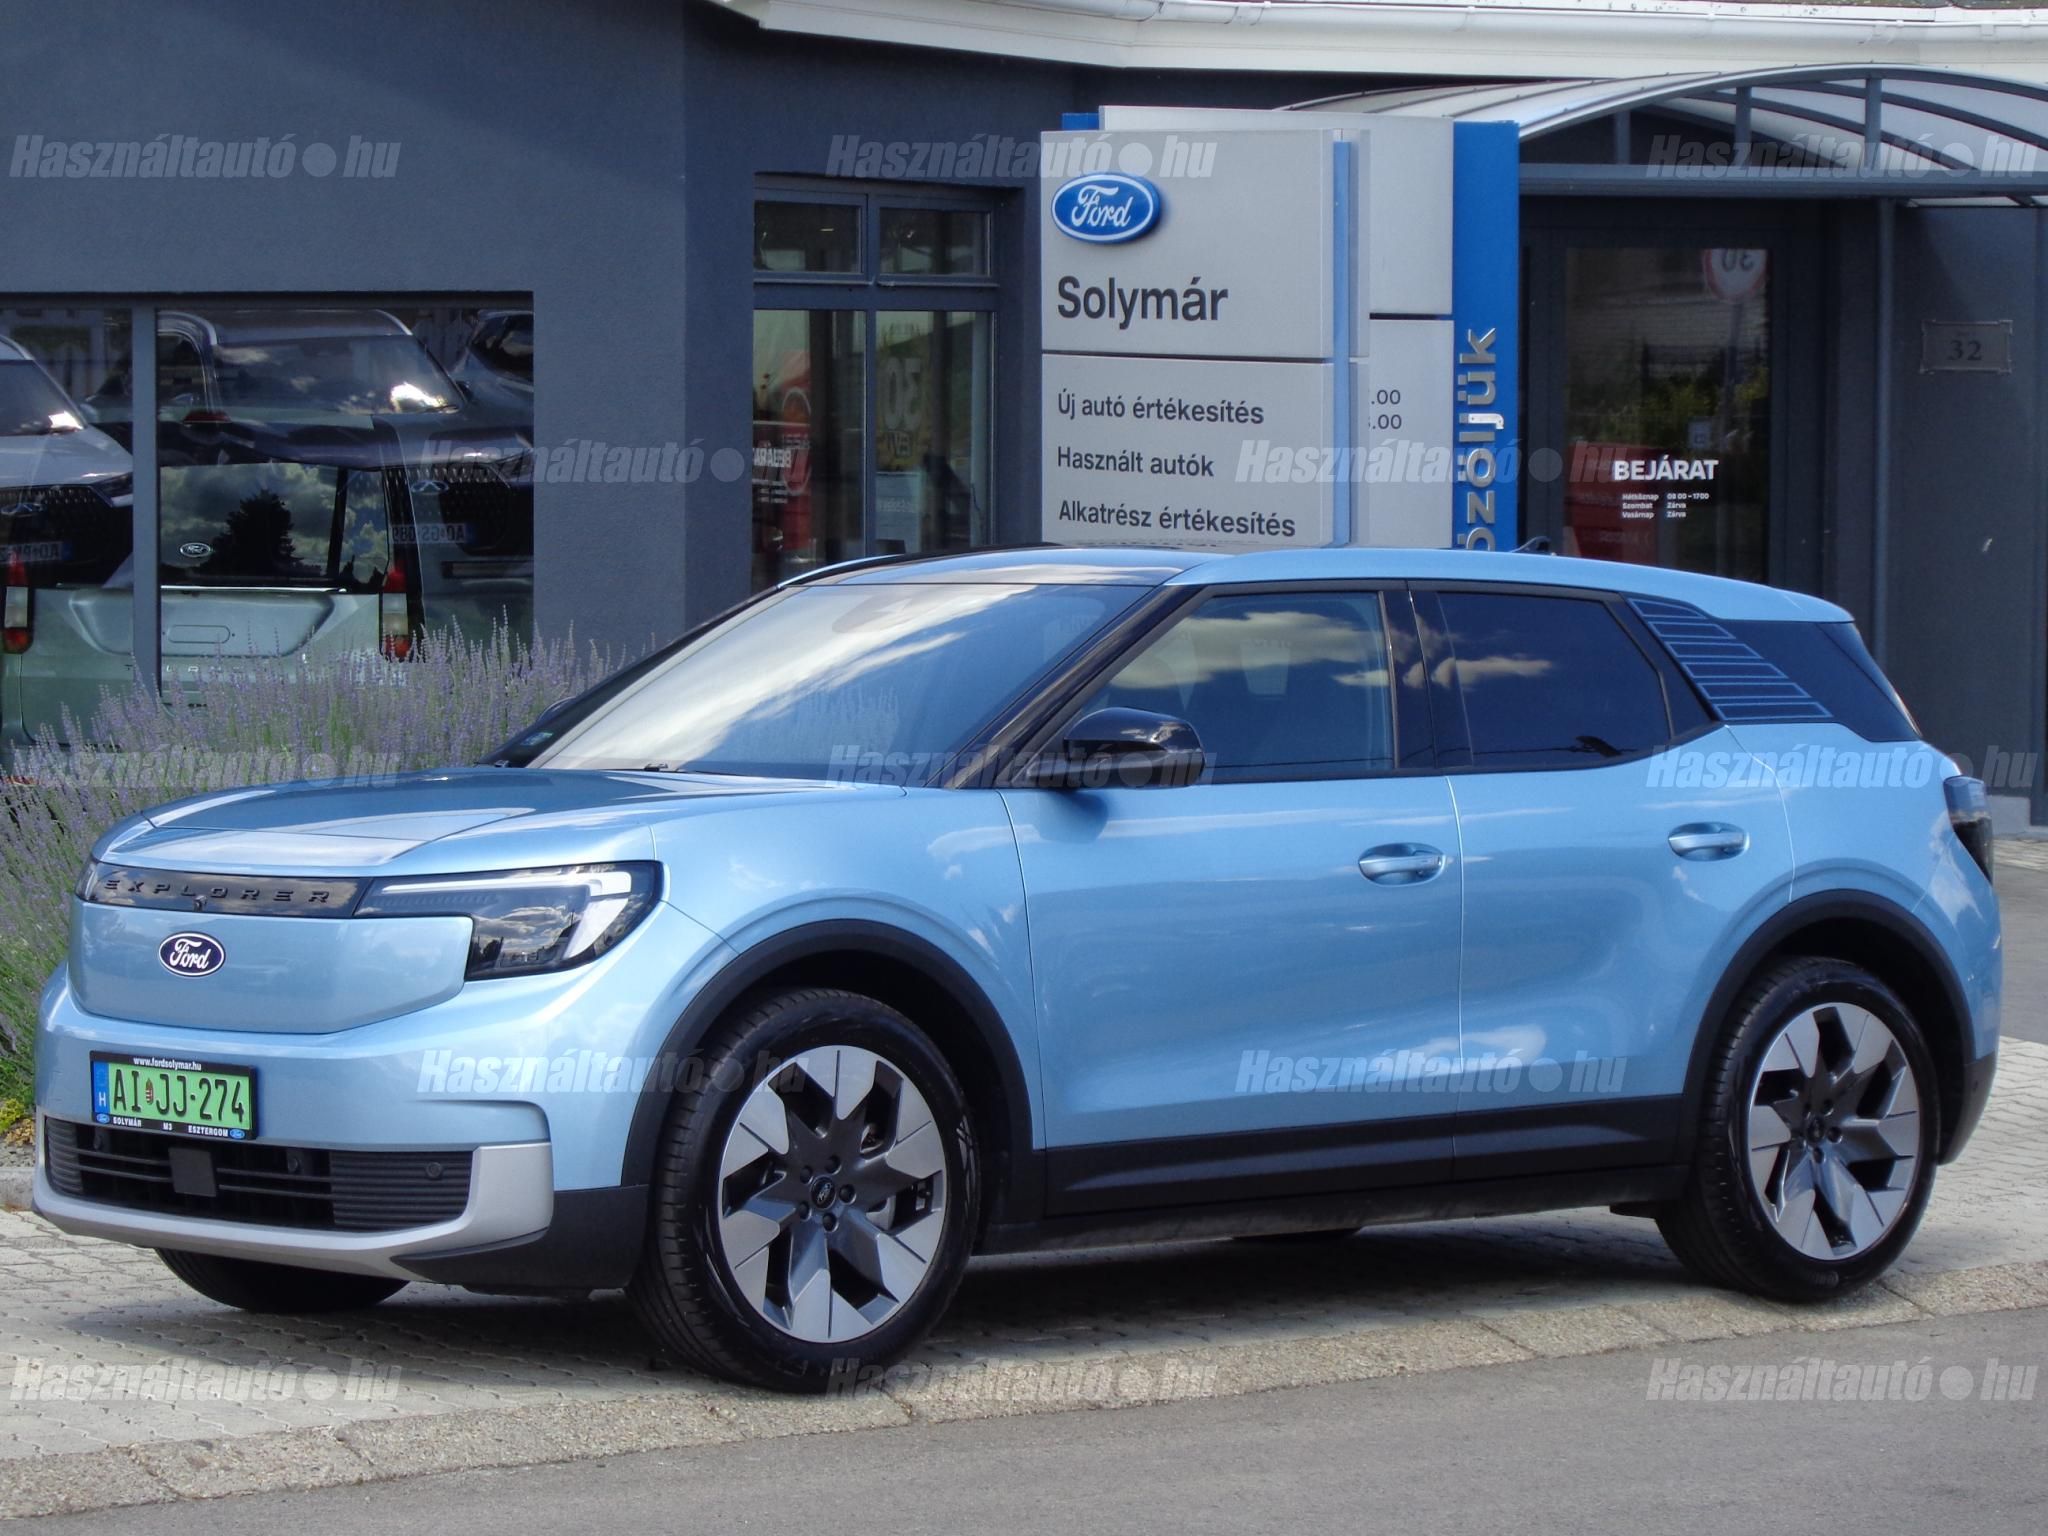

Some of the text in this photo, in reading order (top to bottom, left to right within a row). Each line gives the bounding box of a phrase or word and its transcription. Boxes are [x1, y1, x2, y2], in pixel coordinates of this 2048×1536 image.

[1071, 184, 1134, 227] Ford
[1057, 275, 1229, 330] Solymár
[1948, 340, 1983, 361] 32
[1058, 388, 1265, 424] Új autó értékesítés
[1369, 389, 1401, 405] .00
[1368, 414, 1402, 430] .00
[1458, 328, 1504, 551] özöljük
[1057, 446, 1215, 477] Használt autók
[1613, 454, 1720, 481] BEJÁRAT
[1666, 501, 1687, 509] Zárva
[1666, 510, 1687, 518] Zárva
[1059, 500, 1296, 537] Alkatrész értékesítés
[104, 880, 330, 902] EXPLORER
[169, 938, 212, 969] Ford
[133, 1057, 202, 1071] www.fordsolymar.hu
[98, 1091, 107, 1107] H
[113, 1116, 142, 1128] SOLYMÁR
[188, 1125, 229, 1138] ESZTERGOM
